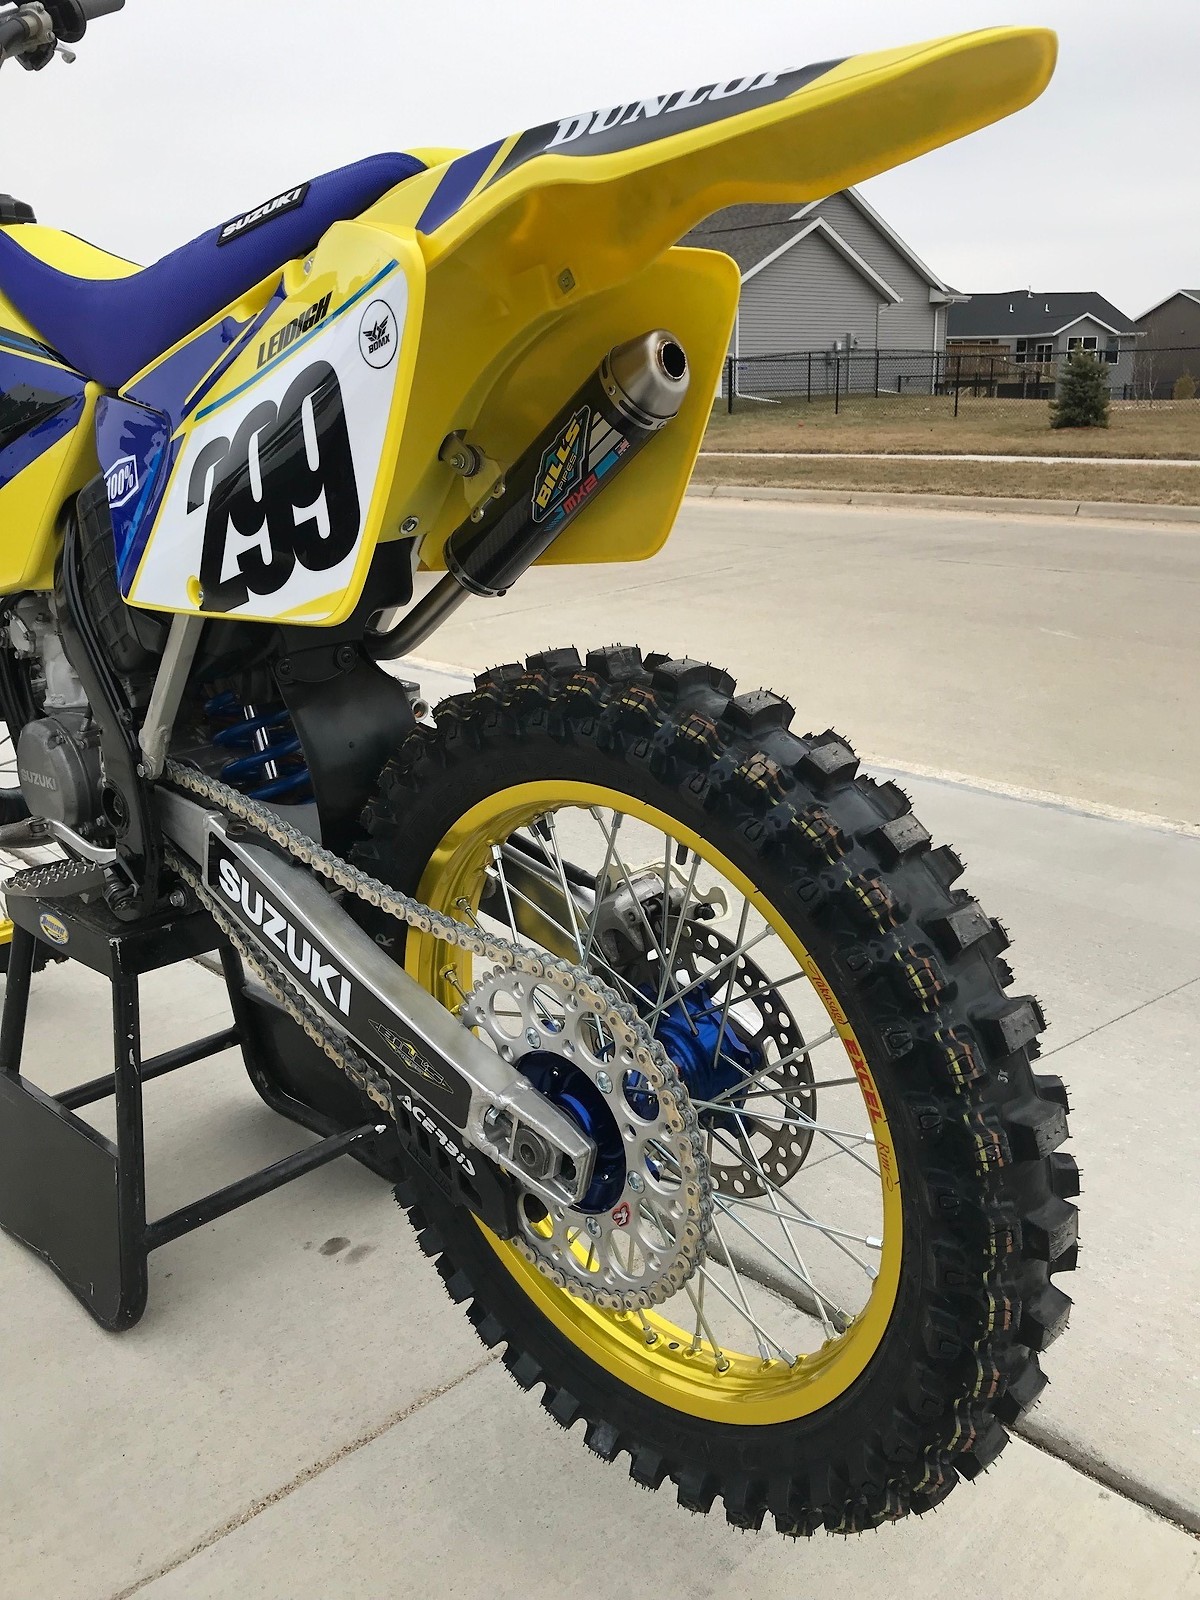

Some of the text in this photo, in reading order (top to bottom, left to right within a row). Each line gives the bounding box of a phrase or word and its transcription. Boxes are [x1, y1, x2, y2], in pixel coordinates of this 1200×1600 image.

[222, 188, 302, 238] SUZUKI
[256, 291, 333, 370] LEIDIGH
[106, 461, 134, 501] 100%
[187, 360, 361, 612] 299
[535, 418, 580, 508] BILL'S
[558, 454, 577, 491] PIPES
[562, 473, 598, 514] MX2
[20, 768, 57, 791] SUZUKI
[218, 858, 352, 1017] SUZUKI
[807, 960, 845, 1025] Takasago
[844, 1038, 883, 1124] EXCEL
[397, 1095, 476, 1176] ACERBIS
